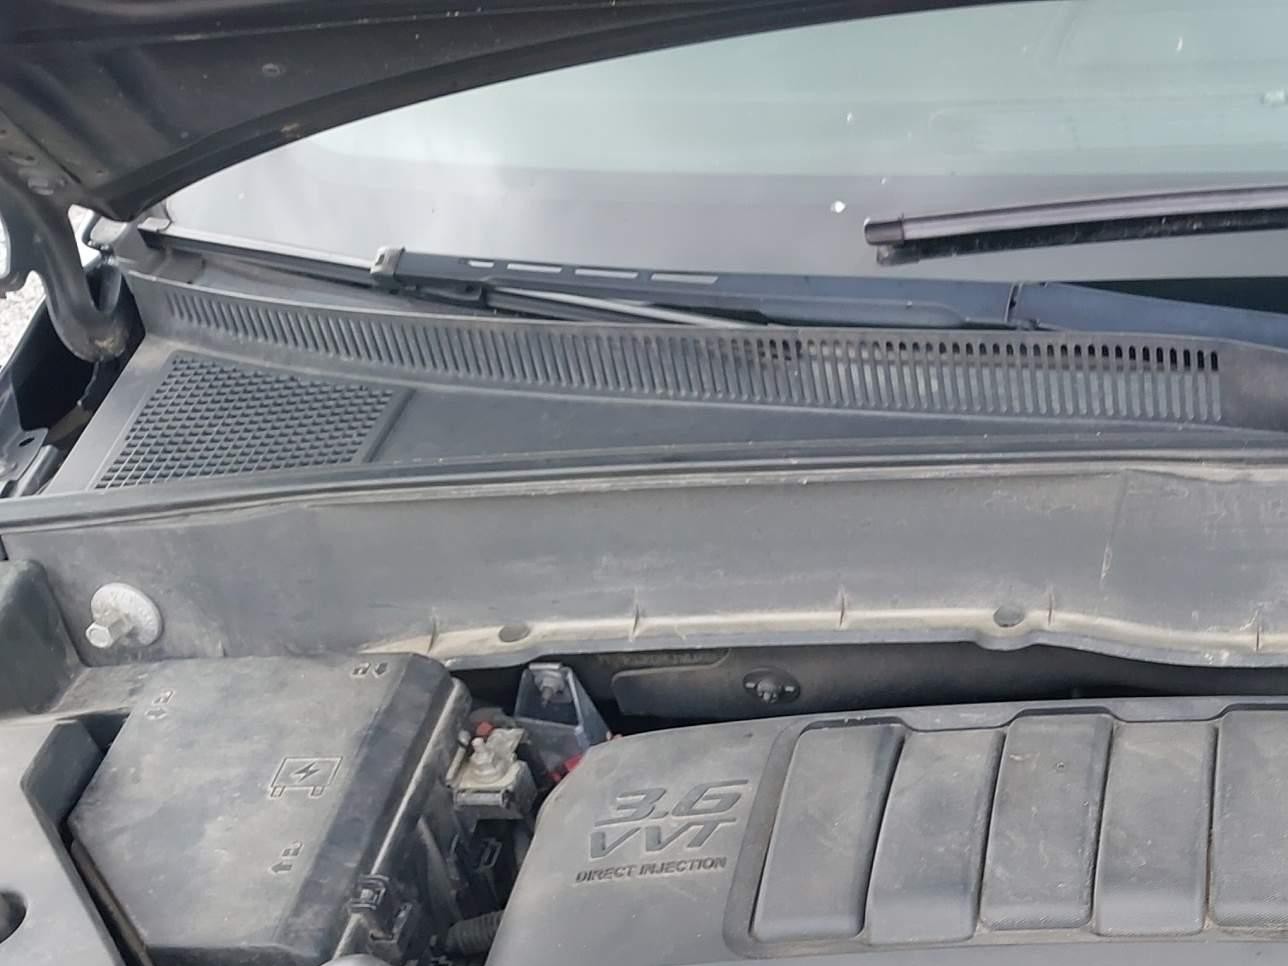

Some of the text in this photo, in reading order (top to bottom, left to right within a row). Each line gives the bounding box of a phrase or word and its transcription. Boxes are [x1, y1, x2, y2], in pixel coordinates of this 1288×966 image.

[594, 779, 749, 828] 3.6
[590, 818, 737, 860] VVT
[575, 856, 728, 884] DIRECT INJECTION
